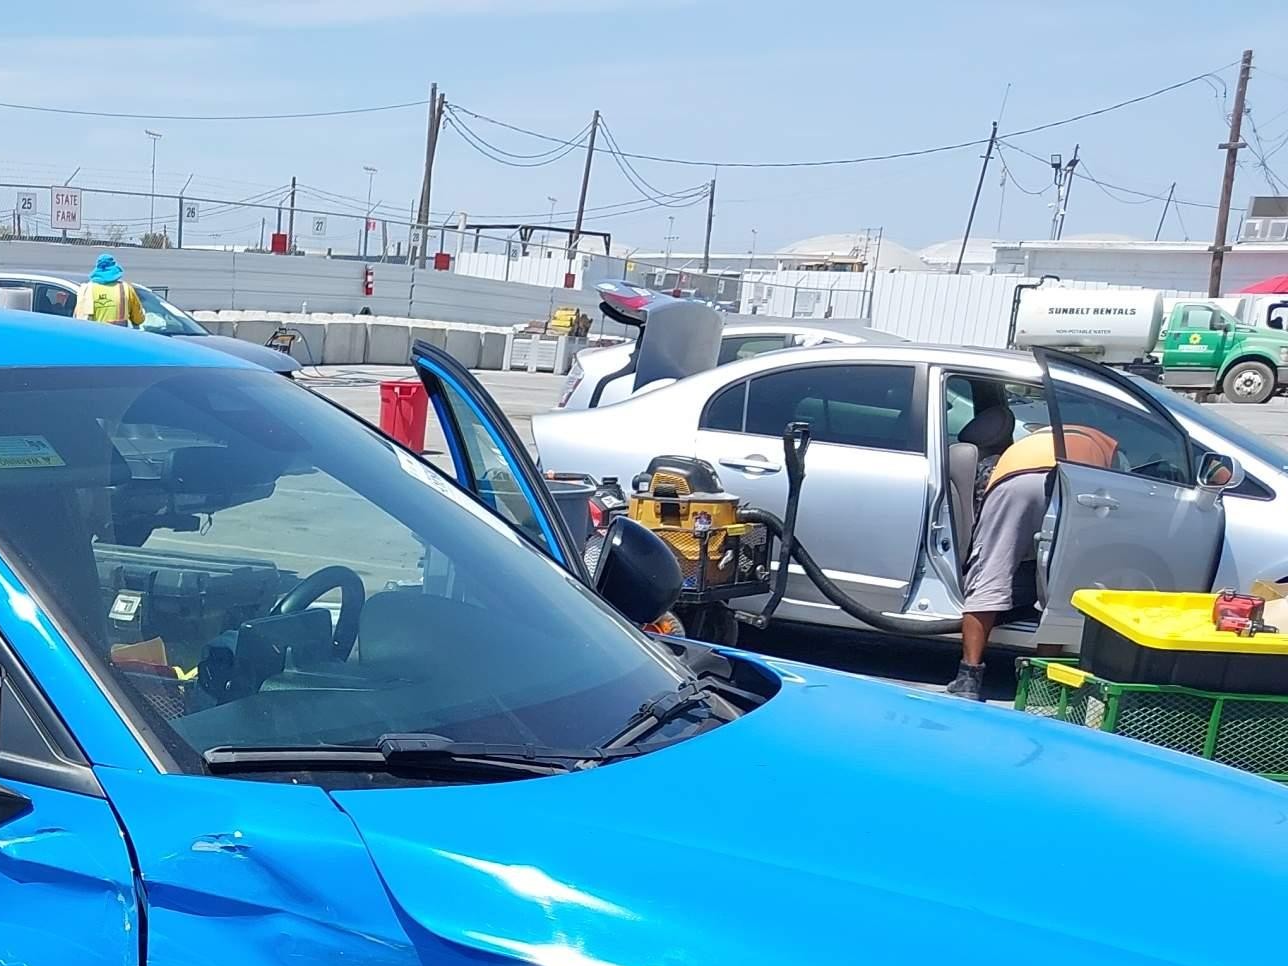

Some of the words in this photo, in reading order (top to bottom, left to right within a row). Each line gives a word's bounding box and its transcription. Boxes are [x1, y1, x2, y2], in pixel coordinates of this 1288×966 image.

[21, 197, 32, 209] 25
[55, 193, 78, 206] STATE
[56, 210, 77, 222] FARM
[315, 220, 324, 232] 27
[1048, 307, 1091, 315] SUNBELT
[1093, 307, 1137, 316] RENTALS
